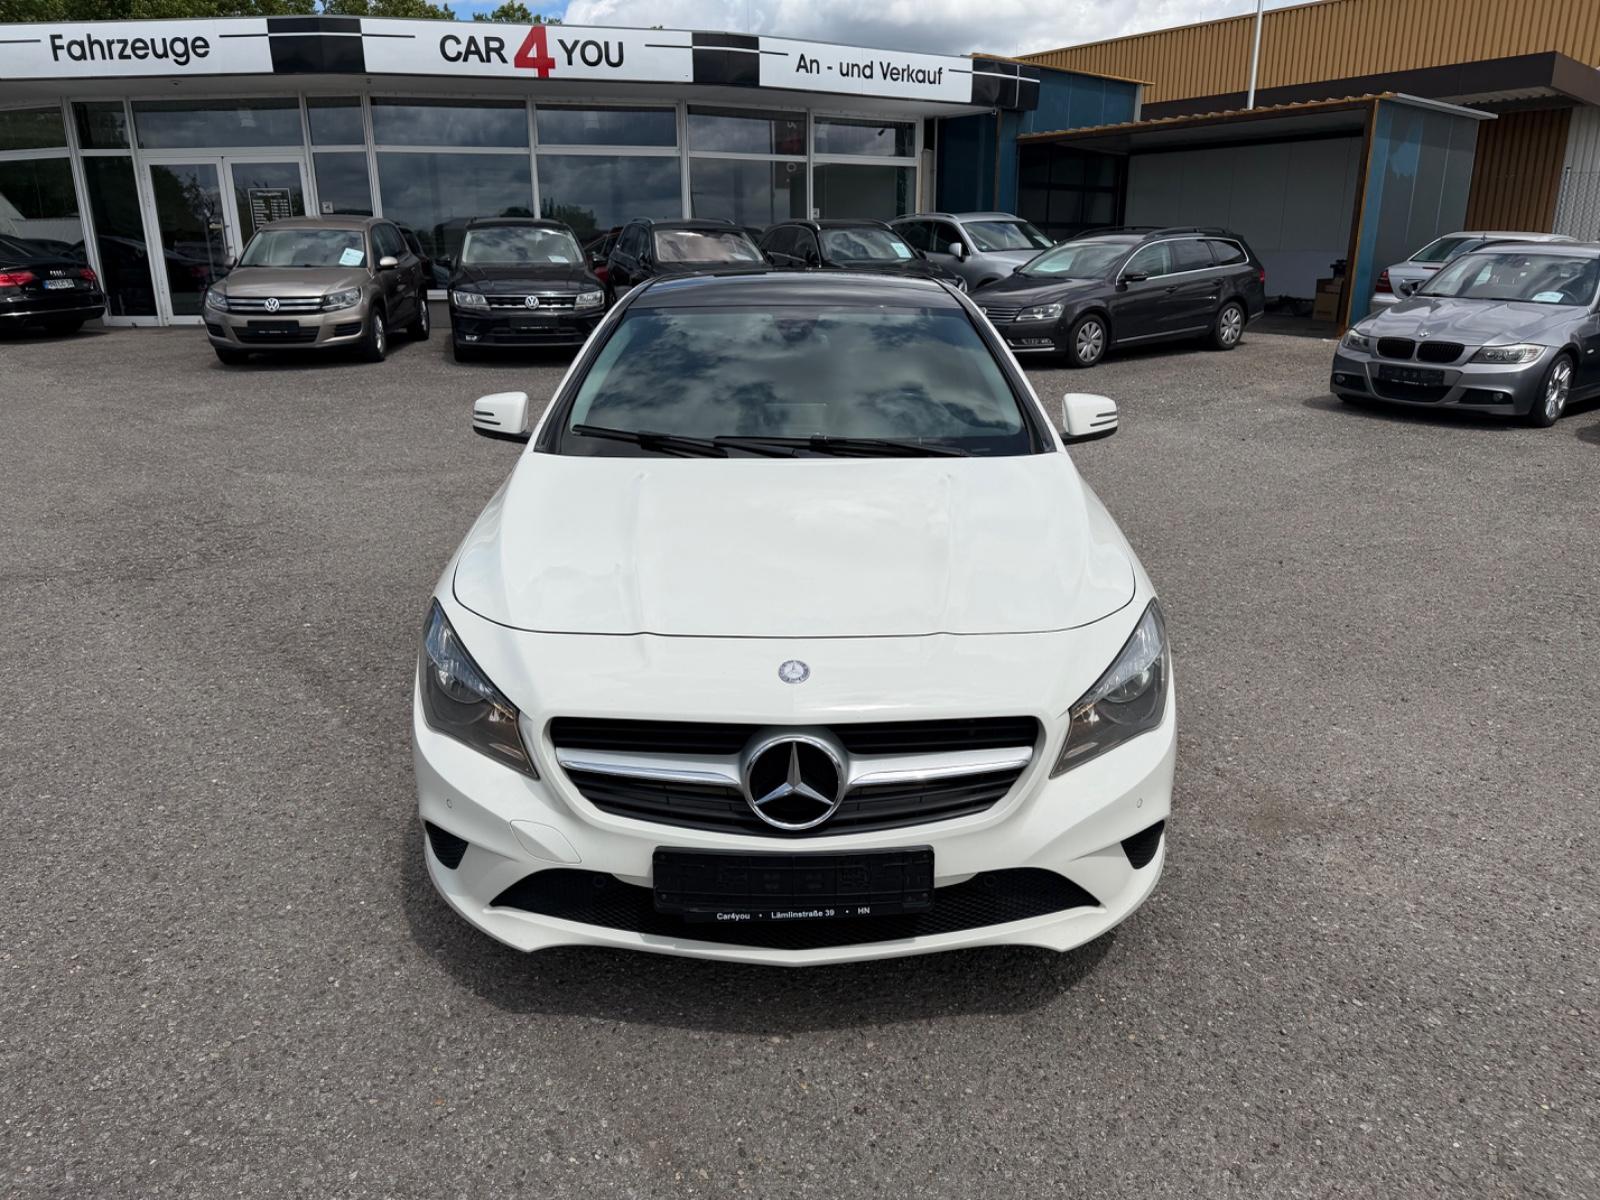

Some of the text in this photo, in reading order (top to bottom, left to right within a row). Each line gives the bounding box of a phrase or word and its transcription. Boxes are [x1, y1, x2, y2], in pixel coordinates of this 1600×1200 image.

[49, 33, 210, 66] Fahrzeuge
[439, 24, 624, 78] CAR 4 YOU
[795, 53, 820, 75] An
[839, 60, 874, 79] und
[879, 61, 943, 85] Verkauf
[716, 912, 751, 921] Car4you
[857, 906, 870, 915] HN
